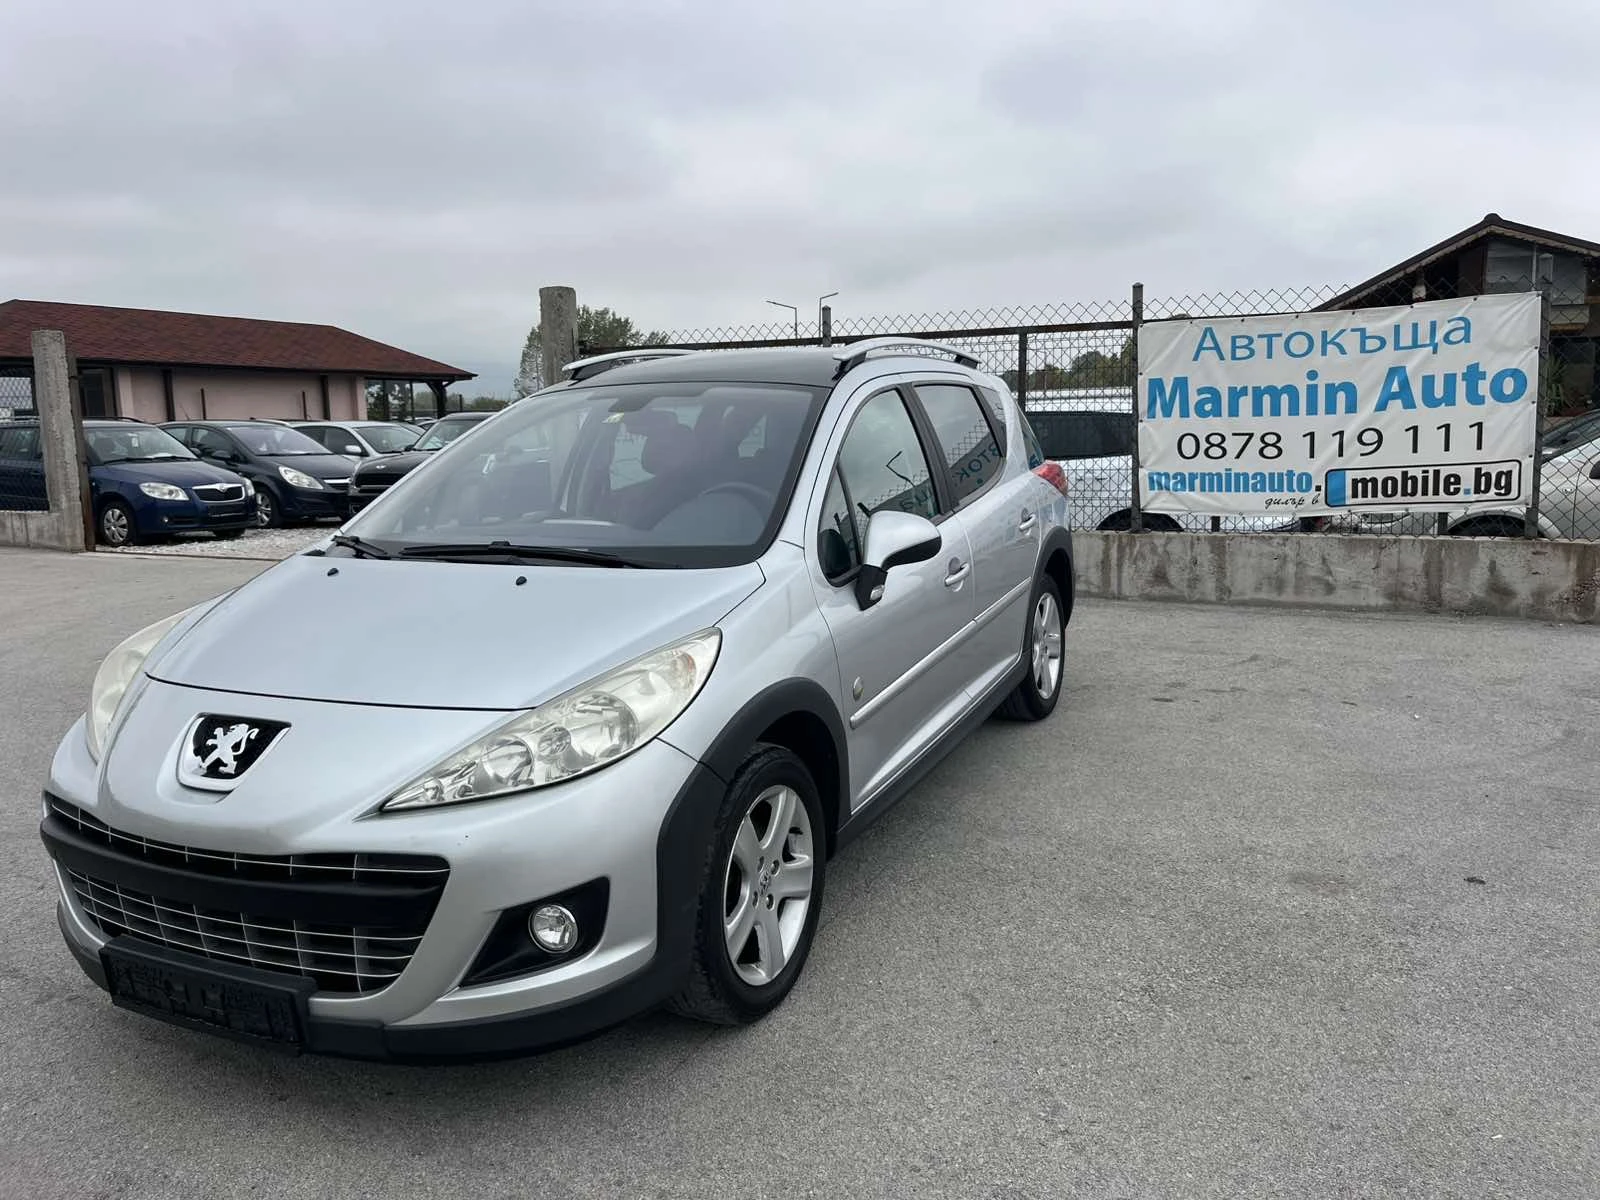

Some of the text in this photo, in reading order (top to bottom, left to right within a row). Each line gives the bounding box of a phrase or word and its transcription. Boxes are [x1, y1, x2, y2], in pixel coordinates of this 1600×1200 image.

[1192, 316, 1472, 362] Автокъща
[1147, 361, 1528, 419] Marmin Auto
[1177, 421, 1483, 460] 0878 119 111
[1351, 467, 1513, 498] mobile.bg
